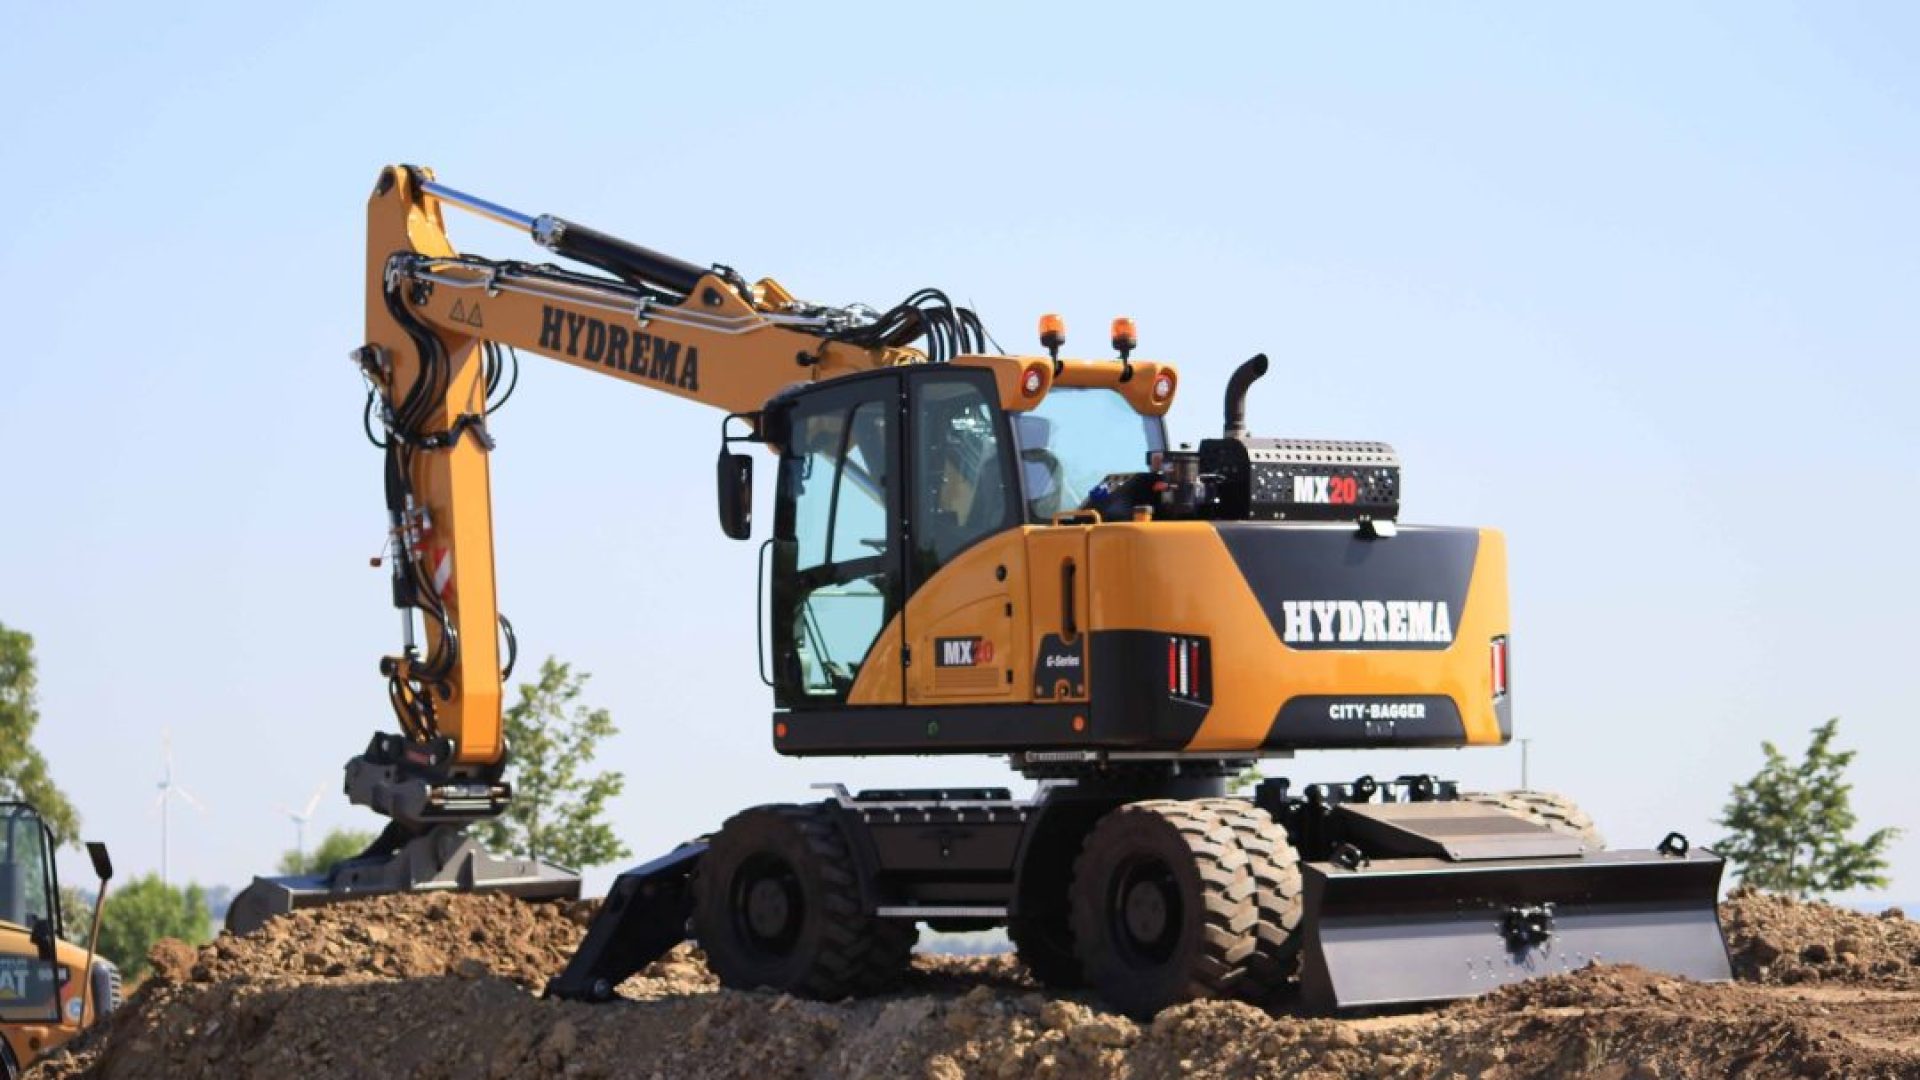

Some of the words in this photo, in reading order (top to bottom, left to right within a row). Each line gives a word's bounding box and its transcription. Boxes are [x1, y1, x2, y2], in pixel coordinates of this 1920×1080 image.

[539, 305, 698, 391] HYDREMA
[1293, 475, 1357, 504] MX20
[1283, 600, 1452, 642] HYDREMA
[943, 640, 993, 665] MX20
[1046, 654, 1080, 667] G-Series
[1329, 703, 1425, 719] CITY-BAGGER
